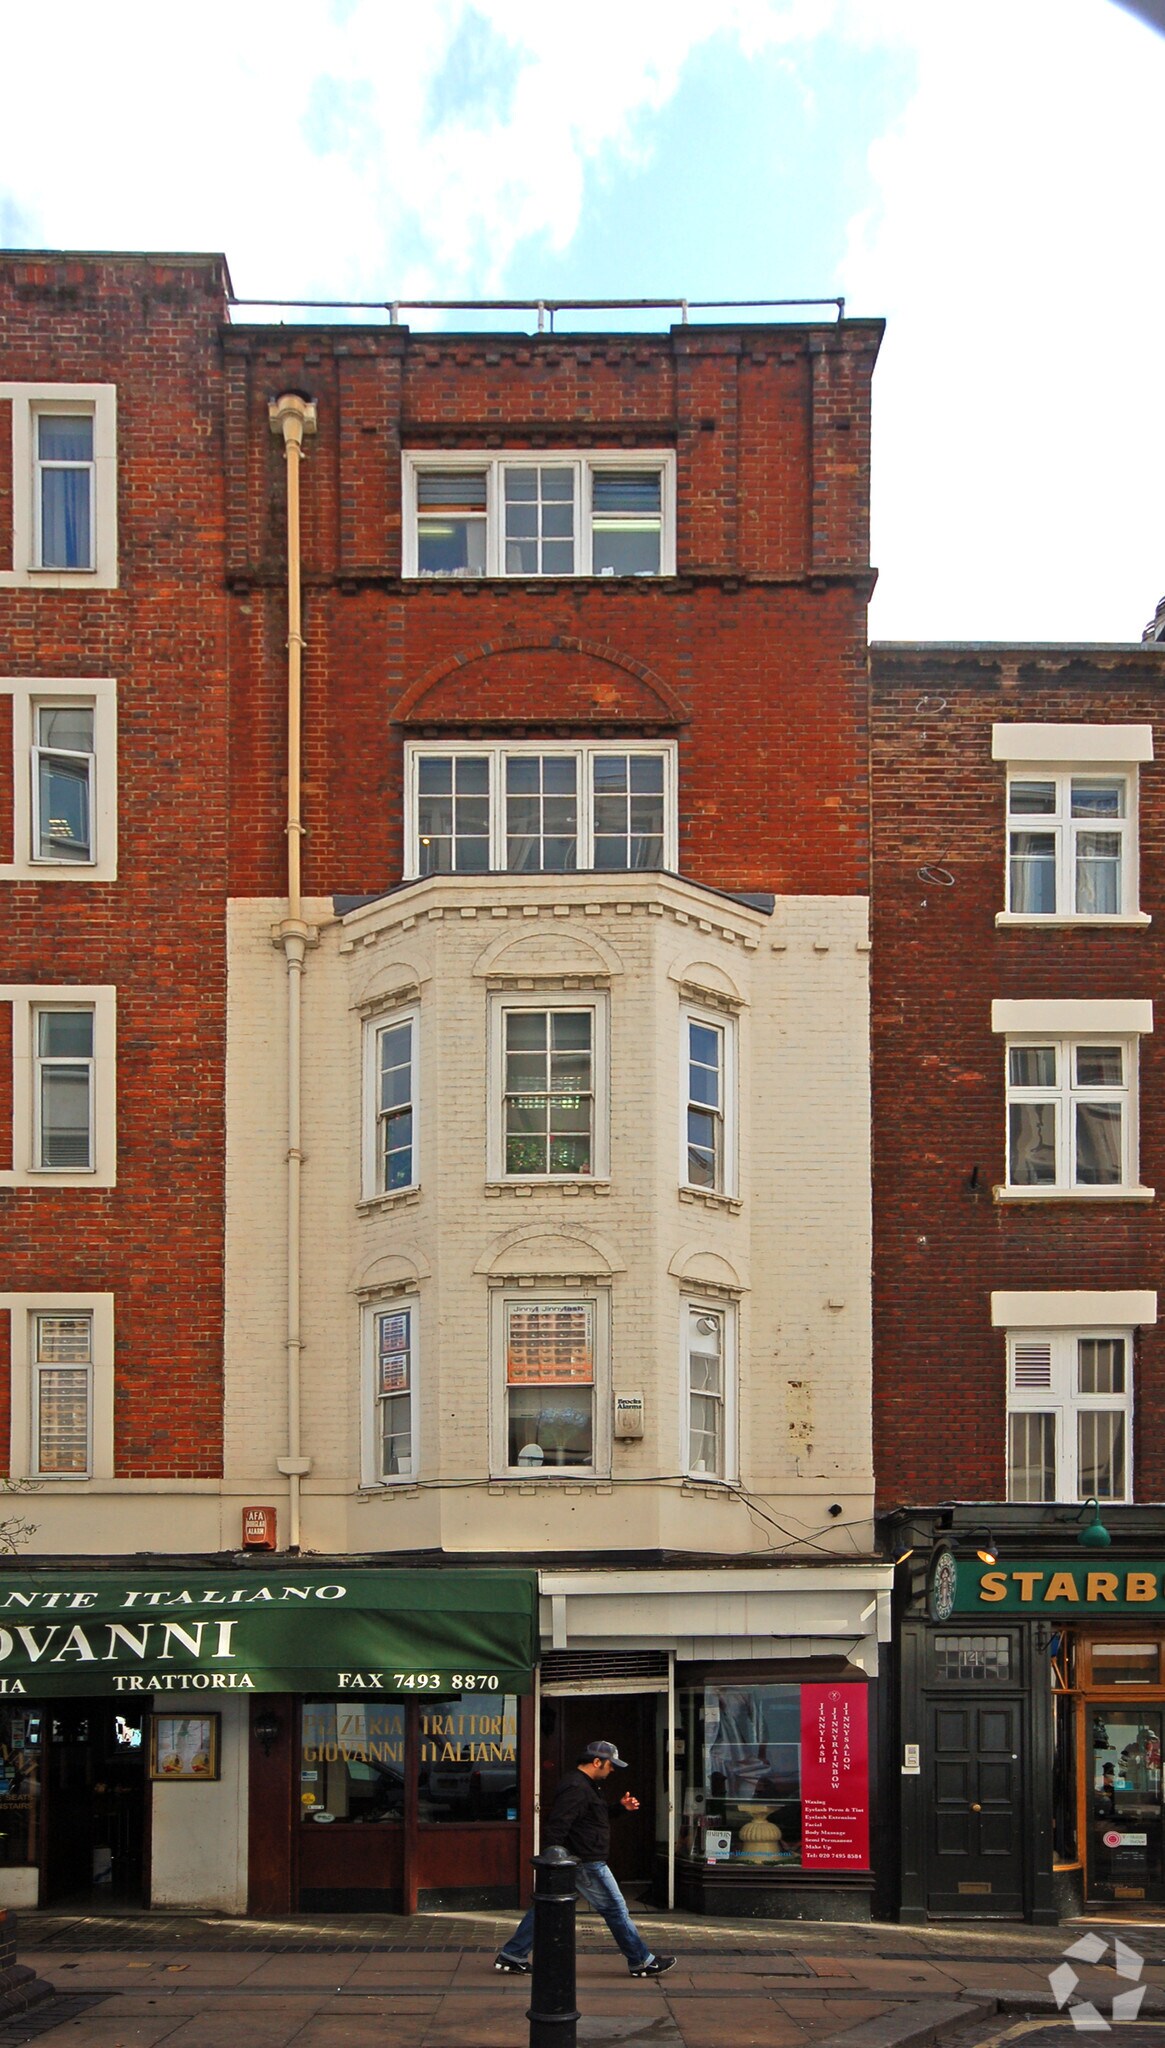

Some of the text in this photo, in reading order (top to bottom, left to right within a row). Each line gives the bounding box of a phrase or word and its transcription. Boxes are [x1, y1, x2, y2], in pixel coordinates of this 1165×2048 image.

[248, 1511, 264, 1520] AFA
[0, 1585, 347, 1608] NTE ITALIANO
[0, 1679, 27, 1694] IA
[112, 1673, 256, 1691] TRATTORIA
[338, 1673, 499, 1690] FAX 7493 8870
[303, 1714, 404, 1736] PIZZERIA
[420, 1714, 517, 1736] TRATTORIA
[818, 1702, 827, 1764] JINNYLASH
[843, 1702, 851, 1770] JINNYSALON
[303, 1741, 404, 1763] GIOVANNI
[421, 1741, 516, 1763] ITALIANA
[831, 1707, 840, 1789] JINNYRAINBOW
